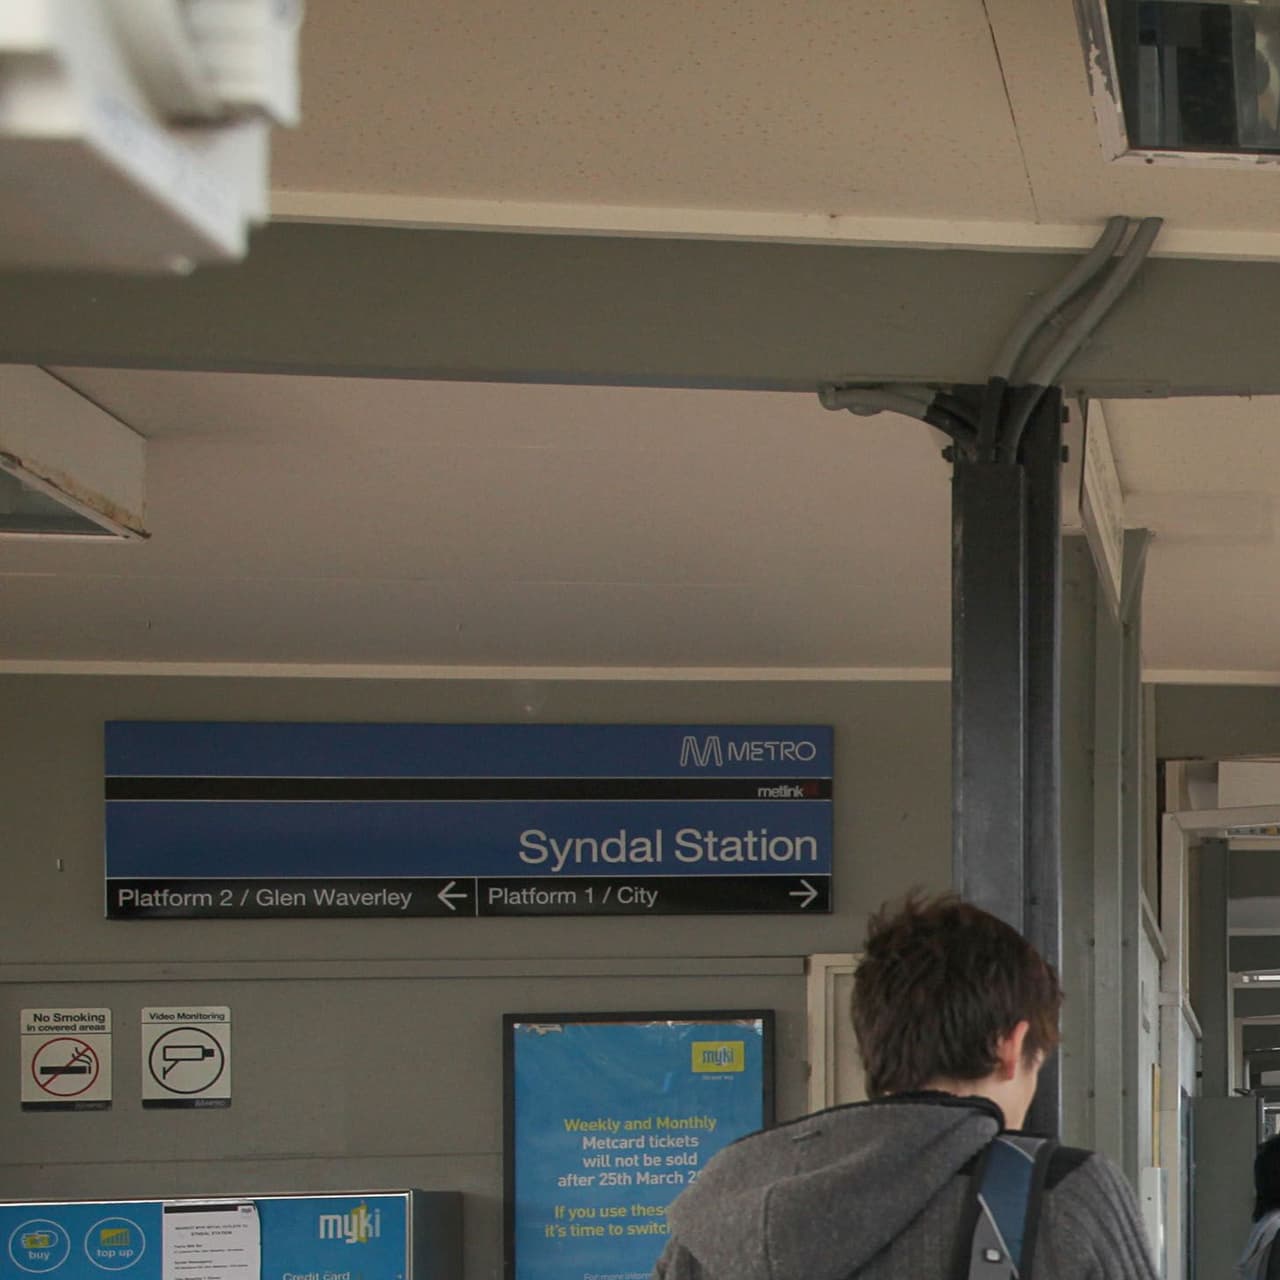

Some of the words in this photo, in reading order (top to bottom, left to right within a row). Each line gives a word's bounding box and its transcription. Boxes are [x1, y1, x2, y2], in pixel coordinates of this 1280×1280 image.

[727, 740, 817, 761] METRO
[757, 785, 804, 798] metlink
[518, 829, 663, 873] Syndal
[674, 828, 818, 864] Station
[118, 888, 213, 907] Platform
[219, 889, 233, 907] 2
[256, 888, 306, 907] Glen
[313, 888, 412, 910] Waverley
[488, 886, 577, 905] Platform
[585, 887, 593, 904] 1
[617, 886, 658, 908] City
[33, 1013, 50, 1022] No
[53, 1012, 106, 1024] Smoking
[149, 1012, 175, 1021] Video
[176, 1012, 226, 1021] Monitoring
[38, 1024, 77, 1032] covered
[703, 1048, 734, 1066] myki
[564, 1118, 621, 1134] Weekly
[624, 1117, 652, 1131] and
[656, 1116, 717, 1132] Monthly
[582, 1135, 645, 1150] Metcard
[649, 1134, 699, 1148] tickets
[582, 1155, 611, 1168] will
[615, 1154, 639, 1168] not
[643, 1153, 662, 1167] be
[666, 1152, 698, 1166] sold
[557, 1174, 595, 1188] after
[599, 1172, 632, 1186] 25th
[636, 1171, 684, 1185] March
[555, 1205, 566, 1219] If
[568, 1206, 596, 1222] you
[600, 1206, 627, 1218] use
[319, 1207, 380, 1244] myki
[545, 1224, 567, 1238] it's
[570, 1223, 605, 1237] time
[608, 1224, 624, 1236] to
[28, 1250, 50, 1261] buy
[96, 1249, 116, 1259] top
[118, 1249, 134, 1258] up
